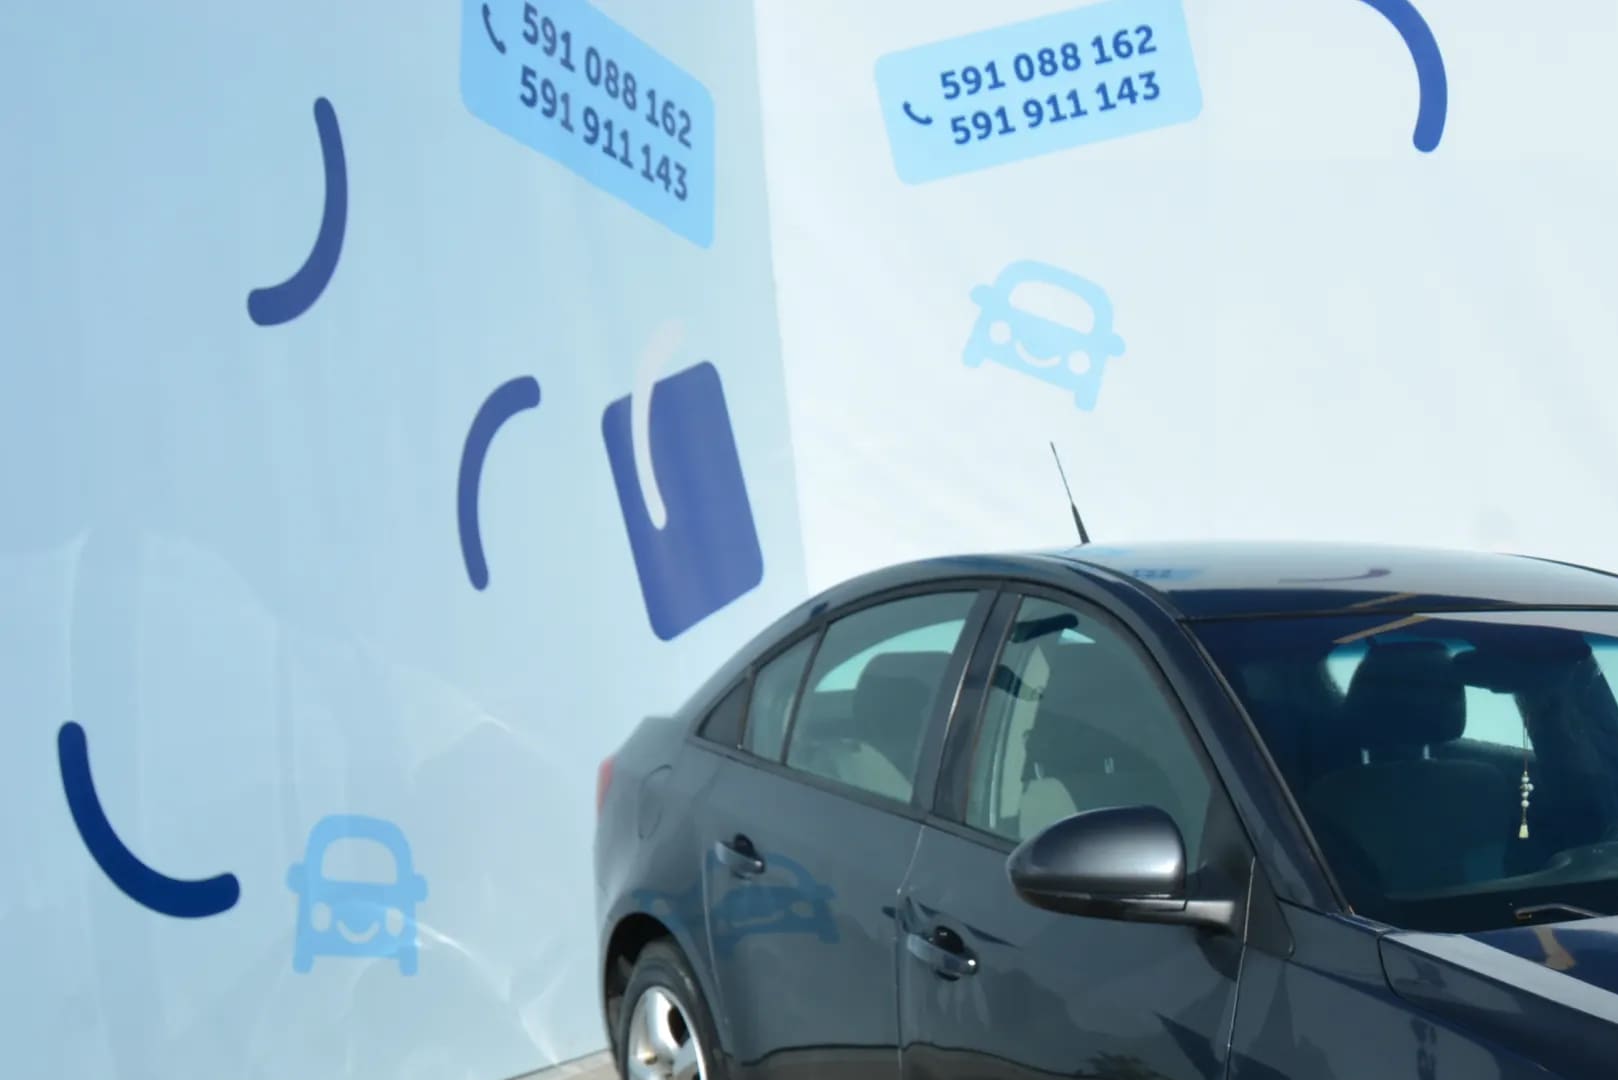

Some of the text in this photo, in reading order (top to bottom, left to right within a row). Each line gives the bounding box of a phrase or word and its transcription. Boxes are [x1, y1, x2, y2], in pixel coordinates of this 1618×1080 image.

[521, 2, 693, 150] 591 088 162
[939, 24, 1157, 101] 591 088 162
[950, 70, 1161, 146] 591 911 143
[518, 63, 688, 202] 591 911 143
